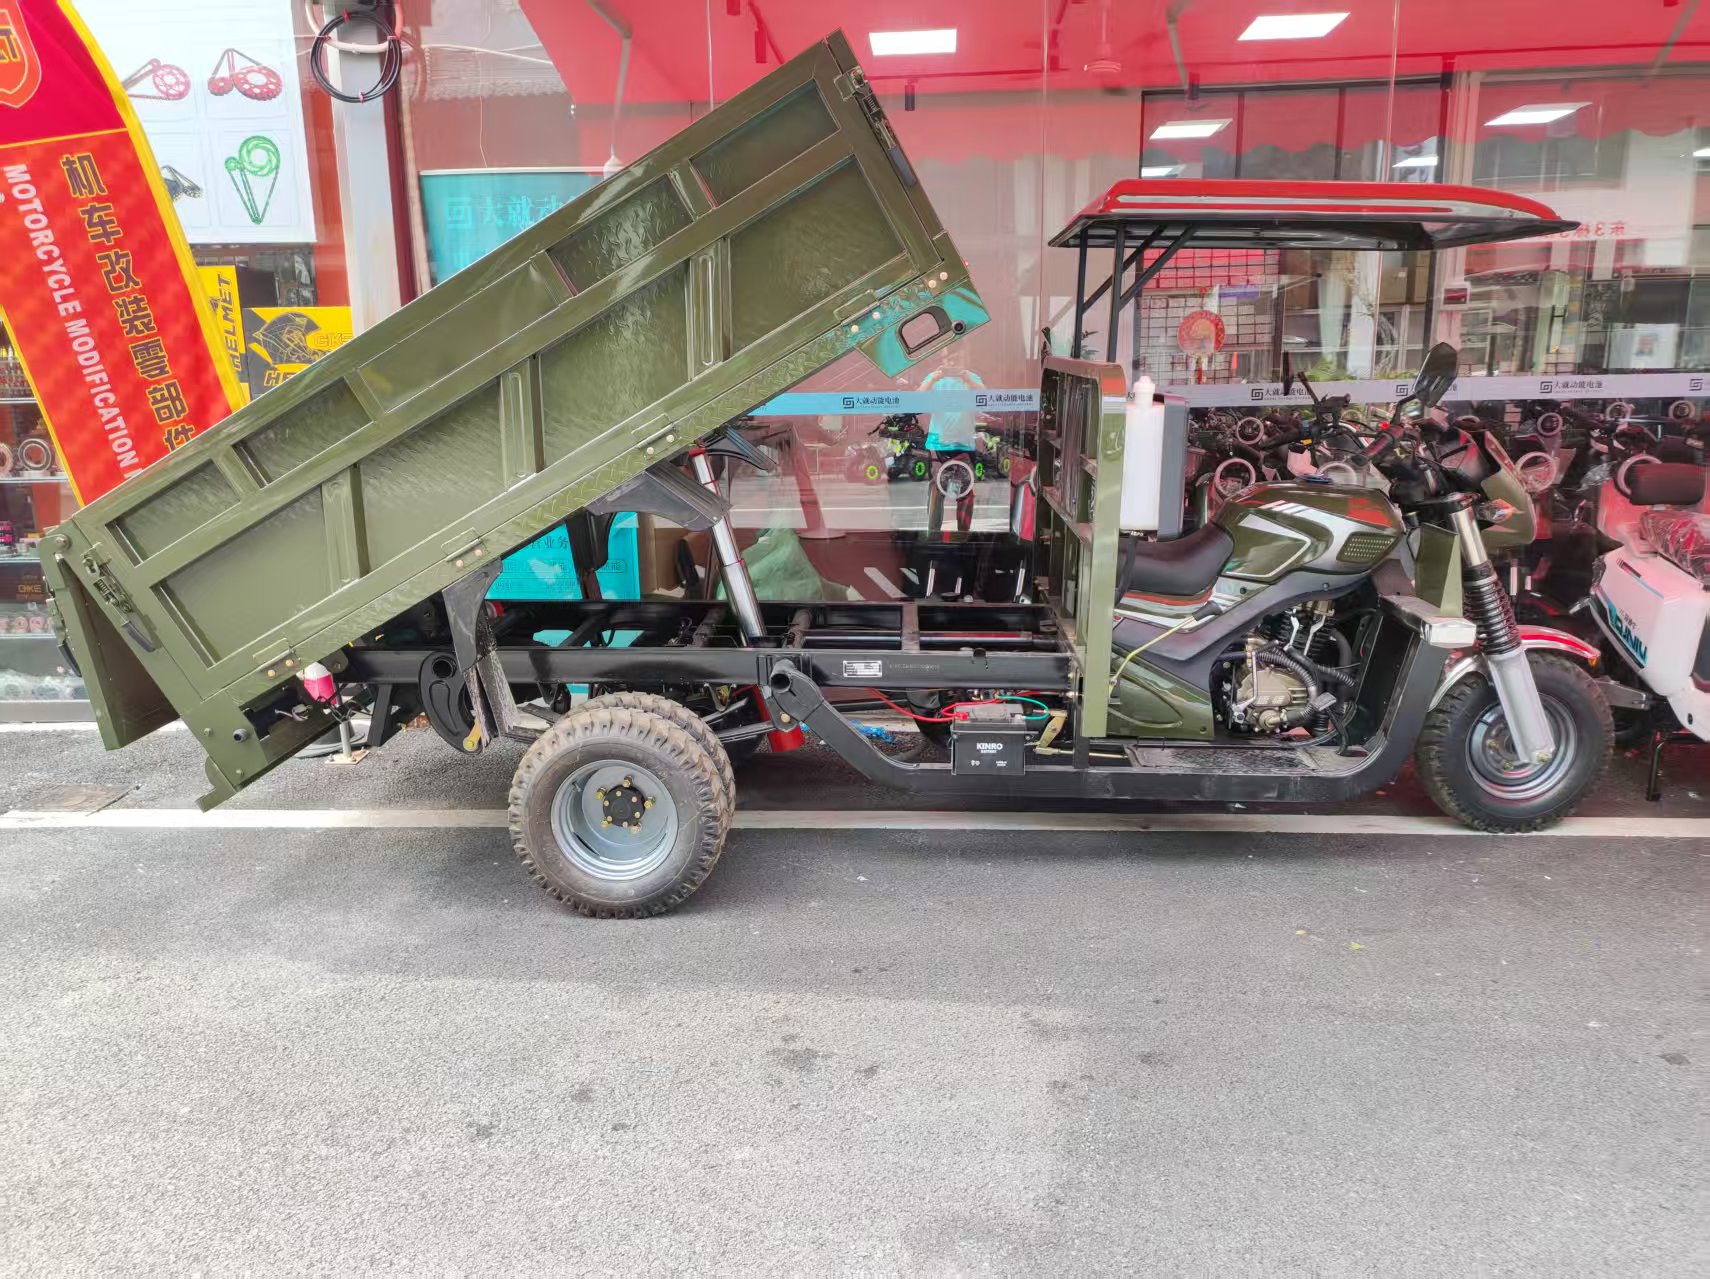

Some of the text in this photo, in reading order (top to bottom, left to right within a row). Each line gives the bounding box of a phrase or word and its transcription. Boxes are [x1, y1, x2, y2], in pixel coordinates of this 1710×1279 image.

[3, 163, 140, 468] MOTORCYCLE MODIFICATION
[60, 153, 195, 452] 机车改装零部件
[976, 742, 1003, 750] KINRO
